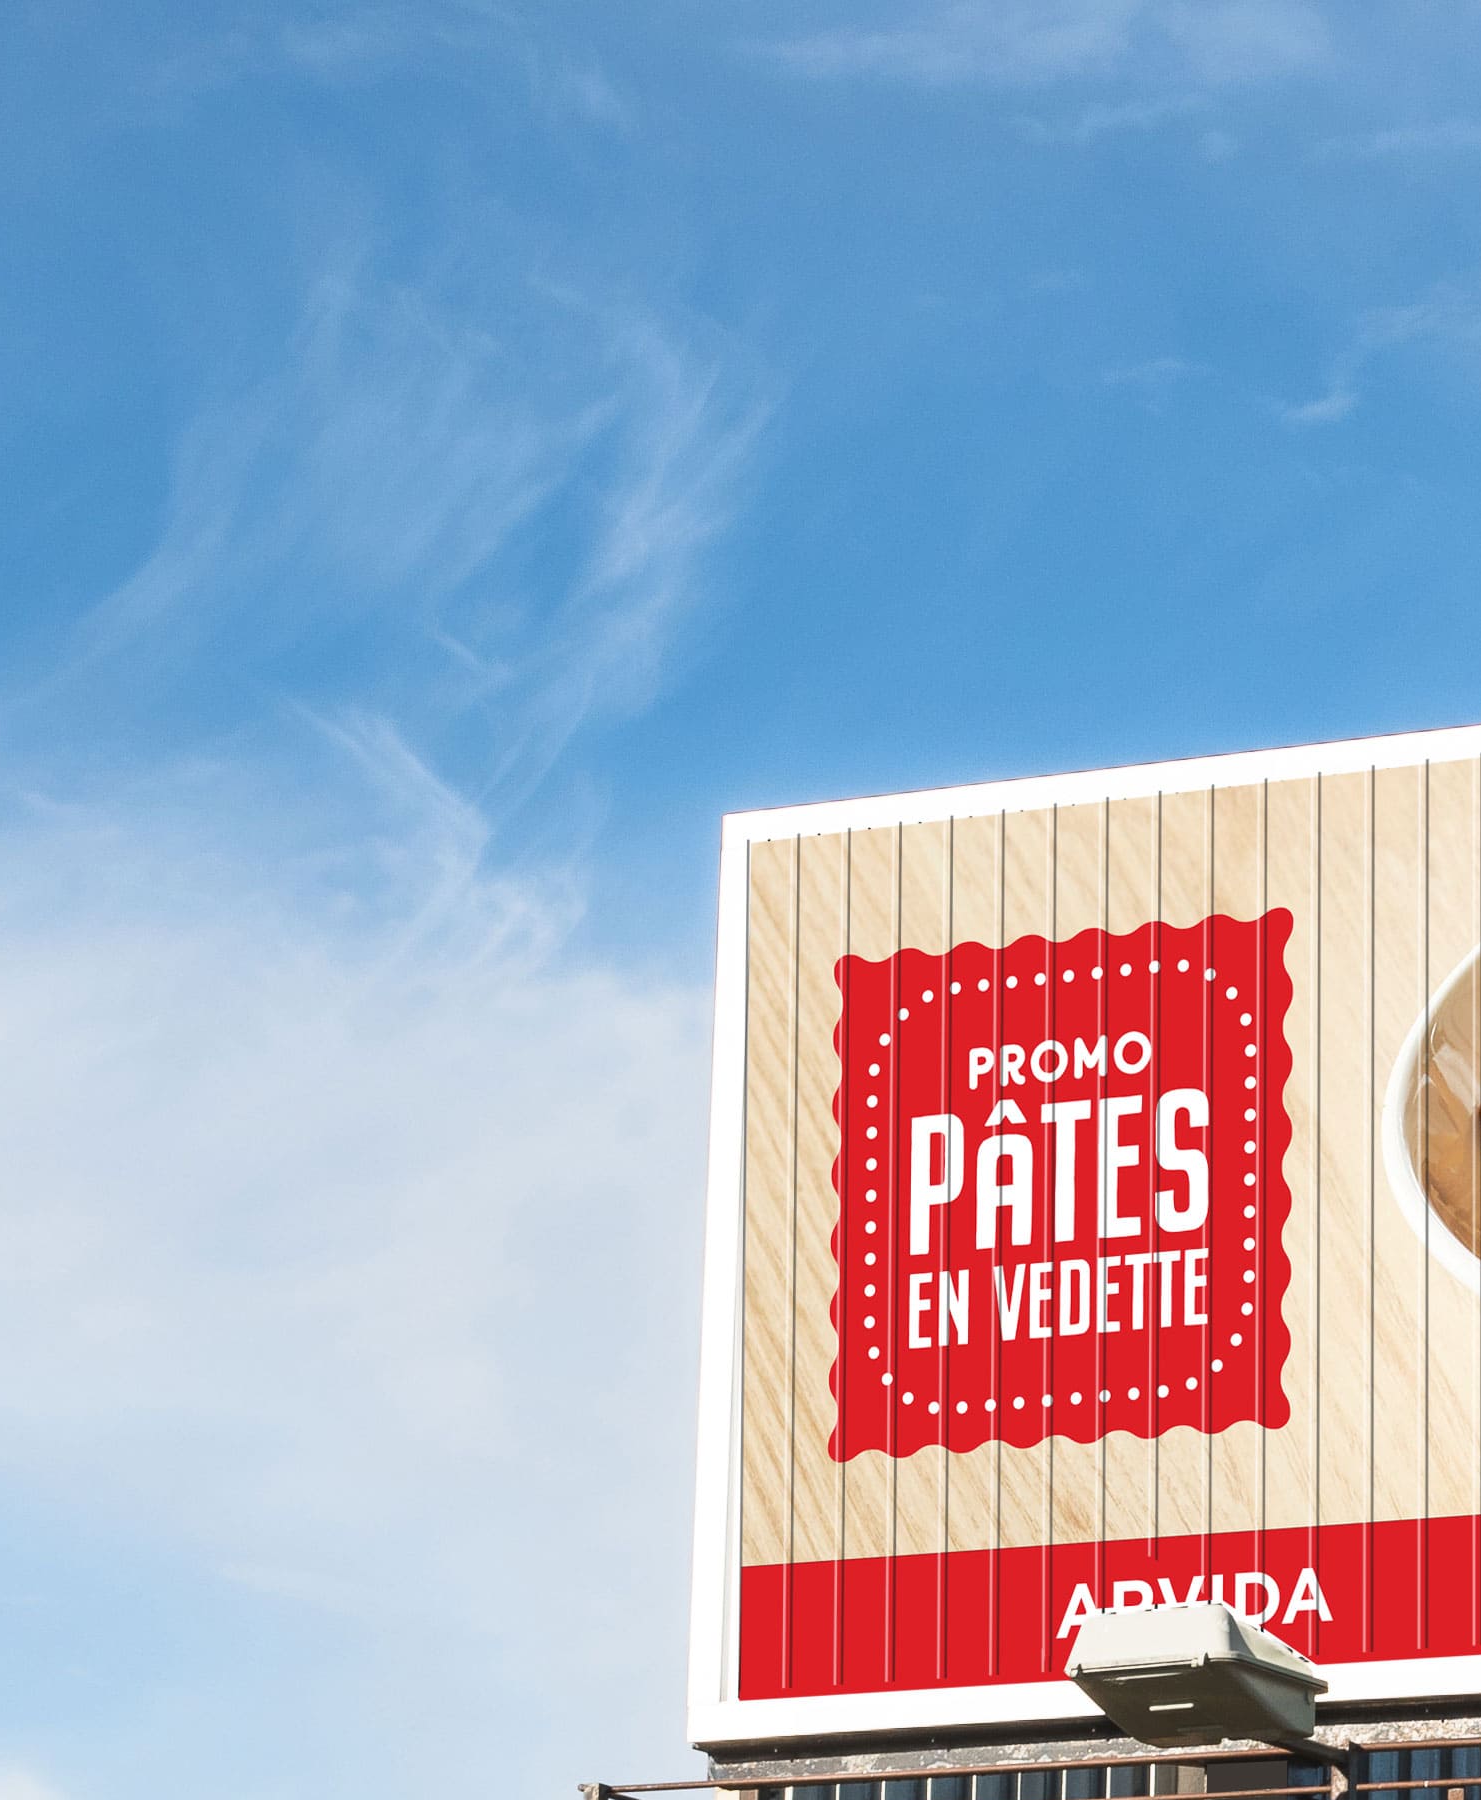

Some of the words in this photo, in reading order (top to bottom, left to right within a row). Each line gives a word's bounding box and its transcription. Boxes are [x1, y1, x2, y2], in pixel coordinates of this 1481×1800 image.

[968, 1030, 1152, 1090] PROMO
[910, 1087, 1211, 1257] PÂTES
[908, 1271, 970, 1350] EN
[994, 1247, 1210, 1343] VEDETTE
